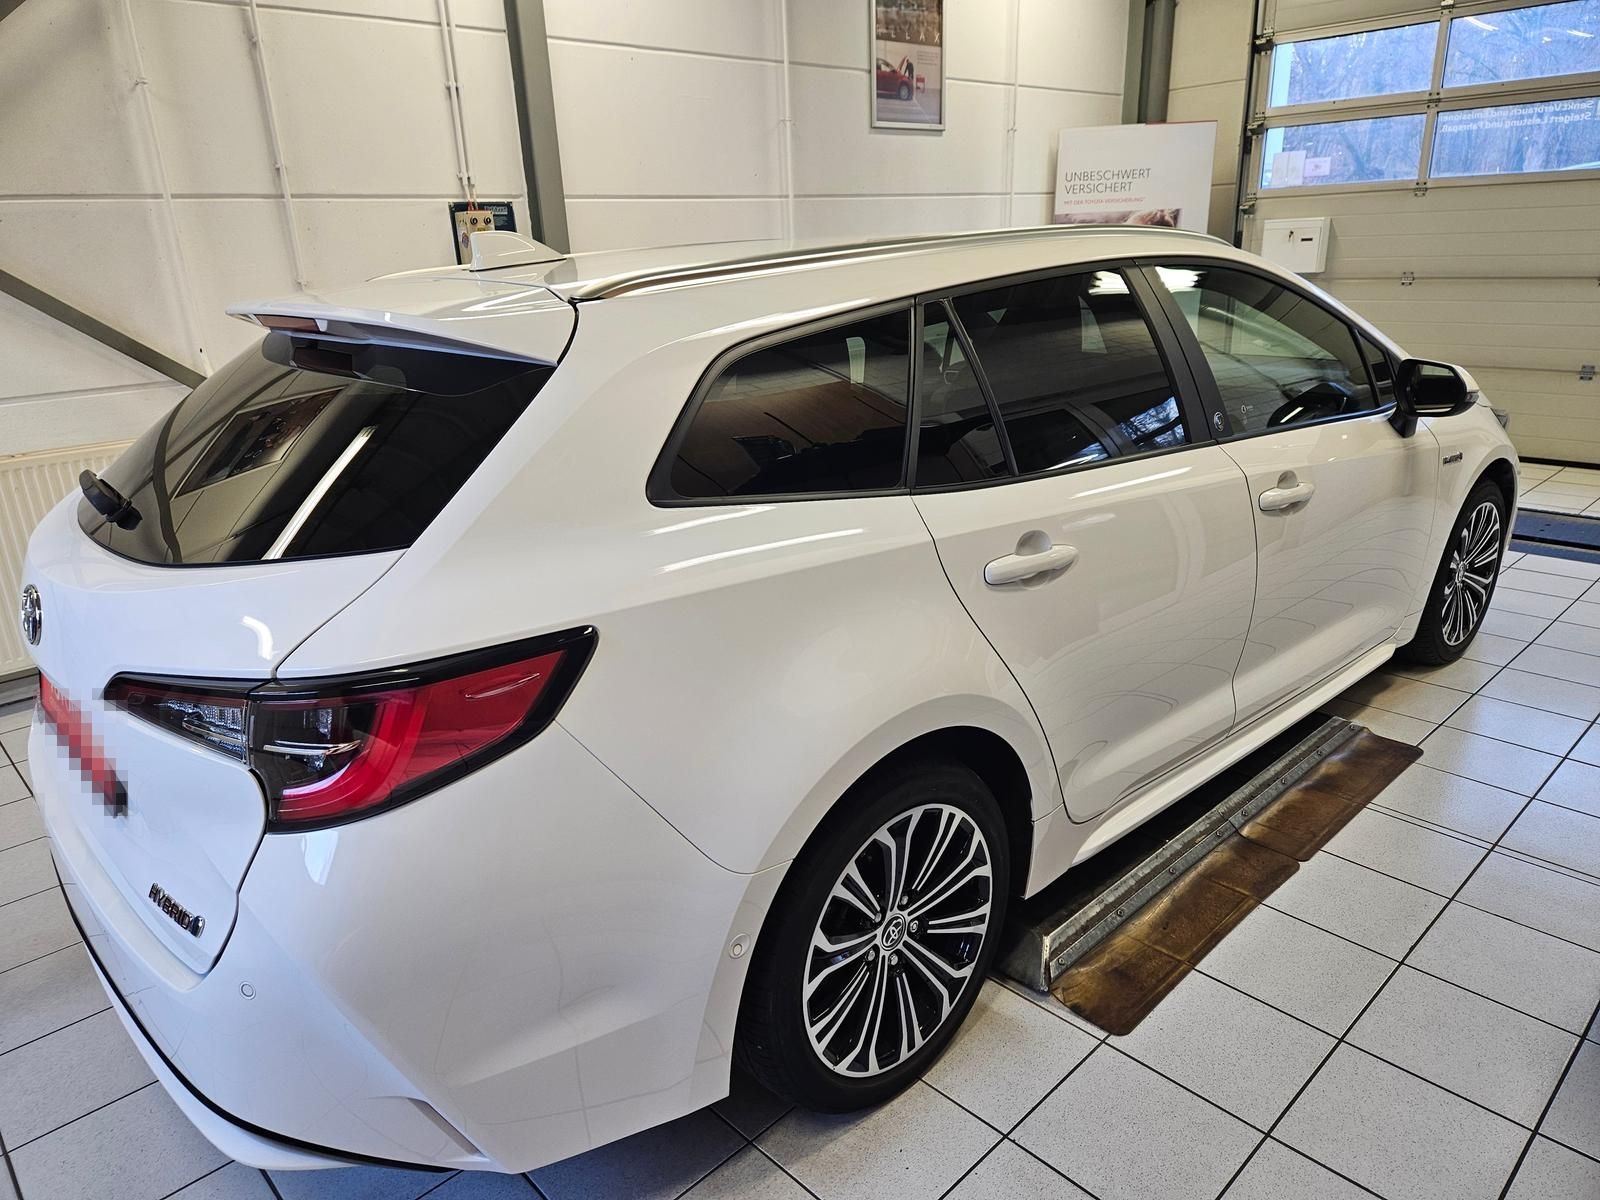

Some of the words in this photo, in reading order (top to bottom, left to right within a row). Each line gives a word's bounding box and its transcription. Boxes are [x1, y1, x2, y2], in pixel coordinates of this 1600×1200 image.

[1065, 168, 1151, 182] UNBESCHWERT
[1064, 182, 1133, 194] VERSICHERT
[148, 882, 193, 931] HYBRID
